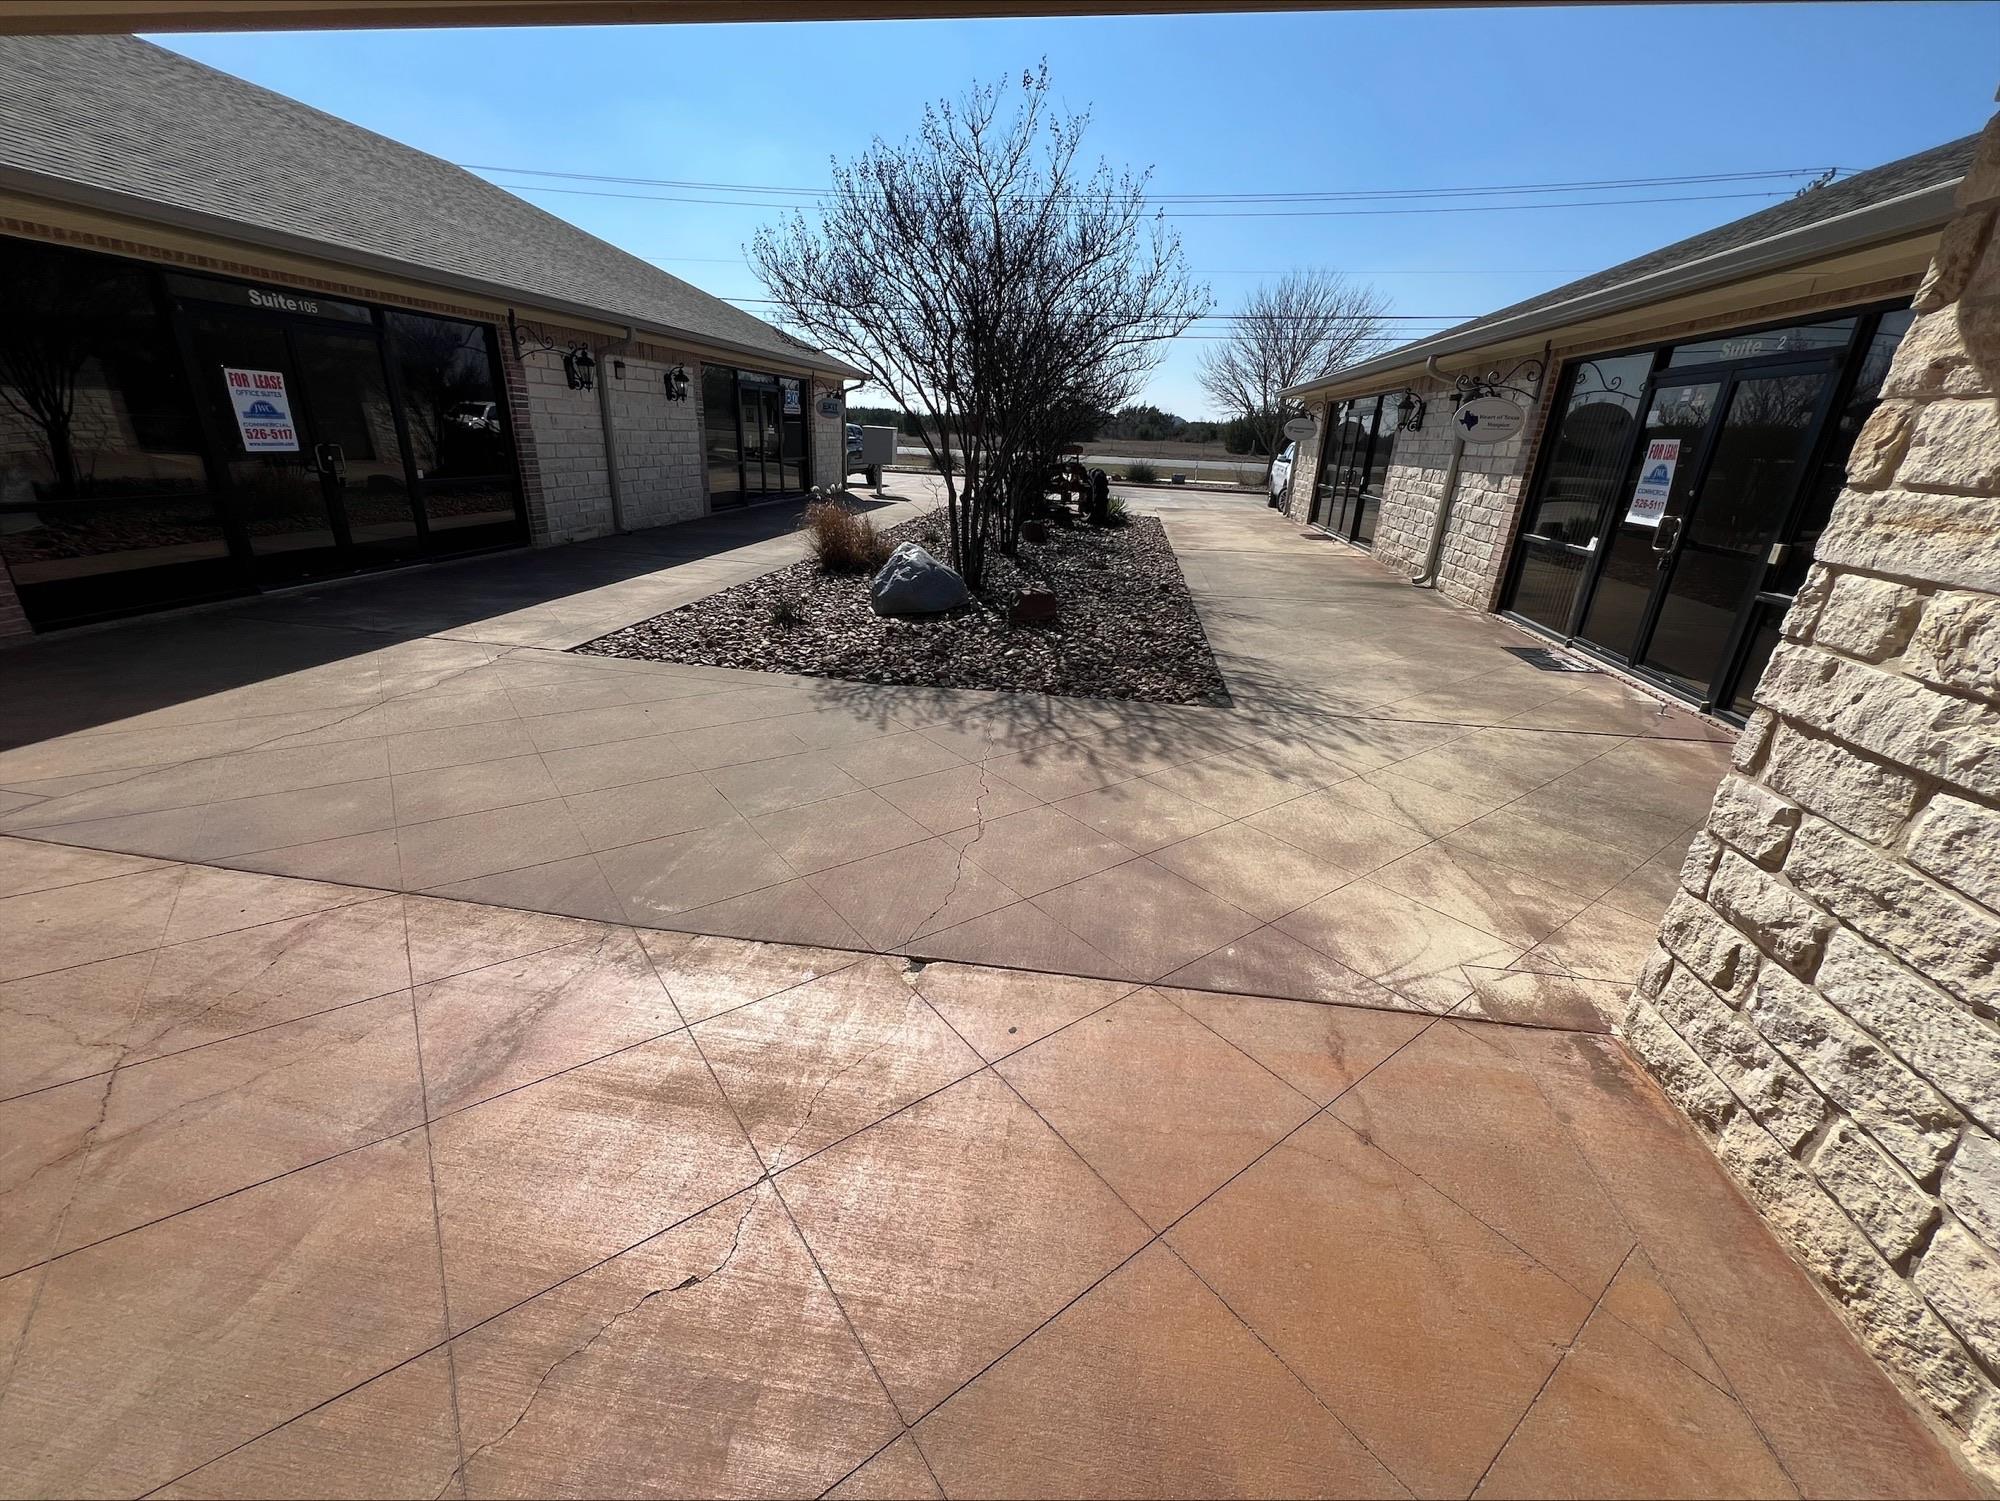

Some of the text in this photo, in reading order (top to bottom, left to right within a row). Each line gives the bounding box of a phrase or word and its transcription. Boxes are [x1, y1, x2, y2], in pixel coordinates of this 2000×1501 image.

[248, 289, 318, 313] Suite 105
[1720, 336, 1787, 358] Suite 2
[228, 372, 283, 390] FOR LEASE
[235, 389, 261, 397] OFFICE
[245, 428, 293, 440] 526-5117
[1648, 443, 1665, 460] FOR
[1634, 498, 1665, 511] 526-5117
